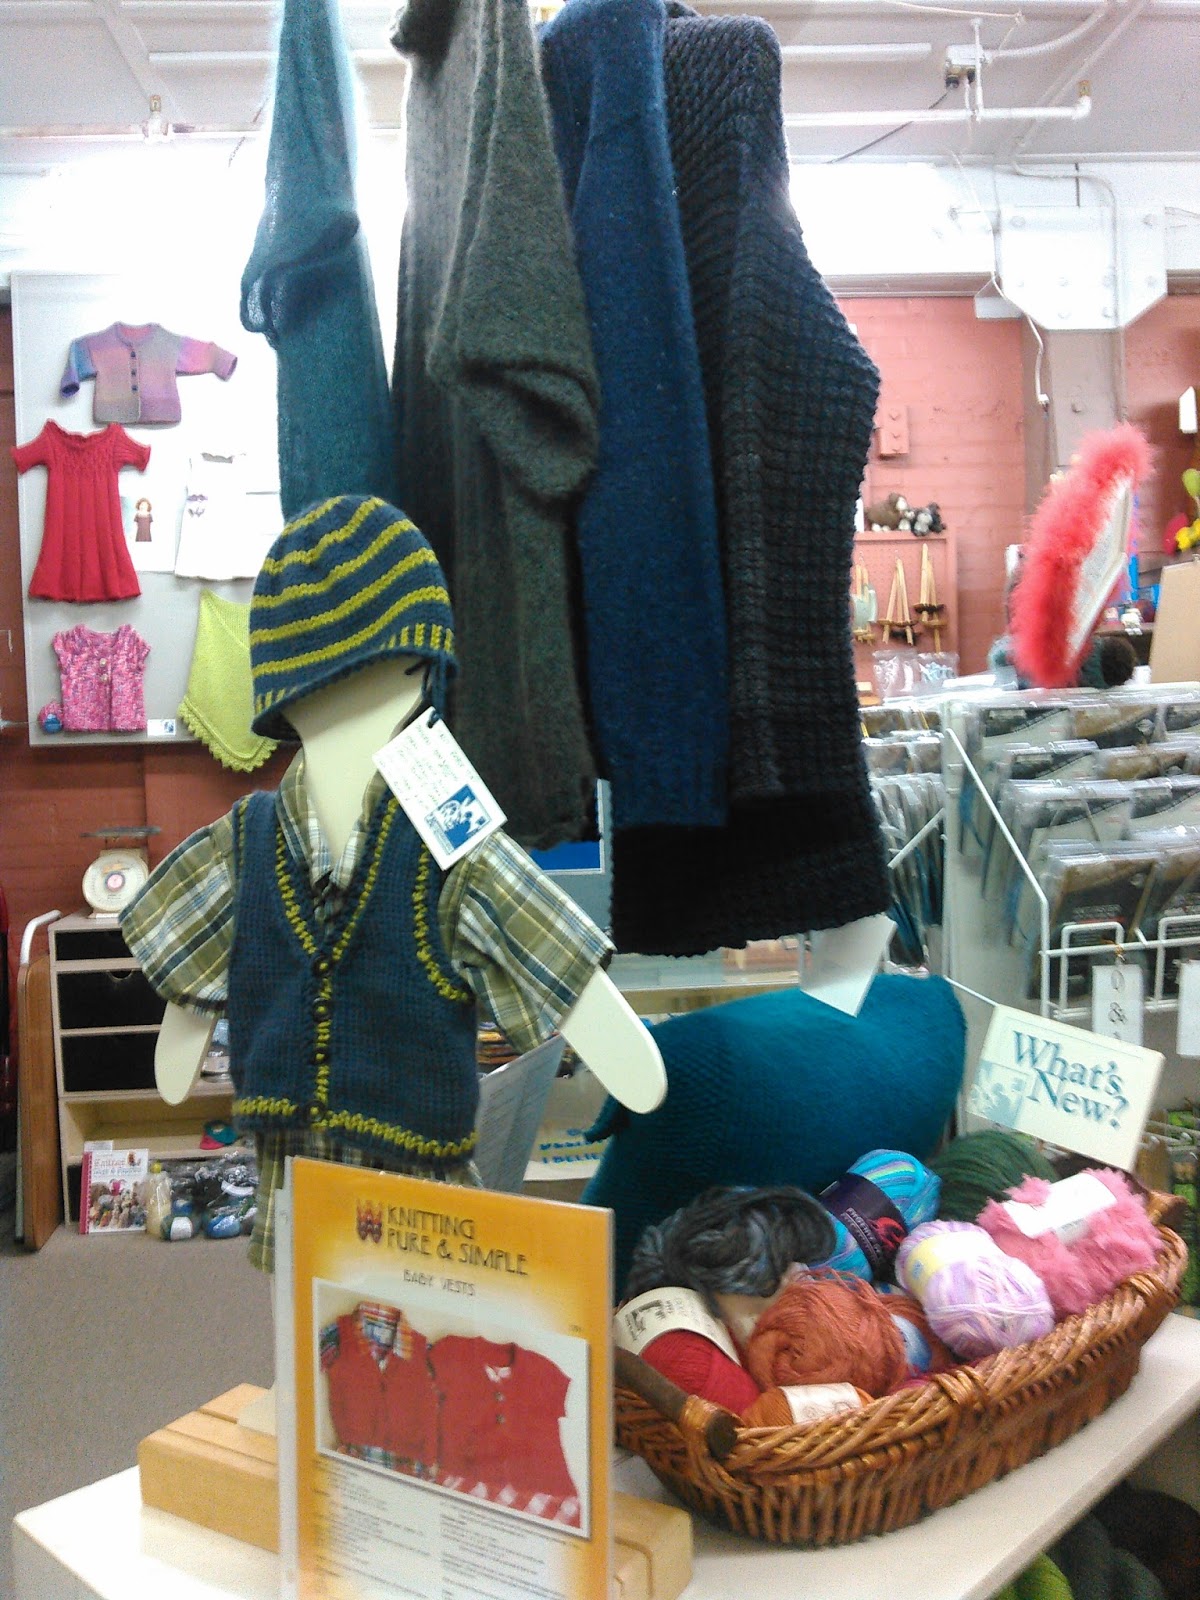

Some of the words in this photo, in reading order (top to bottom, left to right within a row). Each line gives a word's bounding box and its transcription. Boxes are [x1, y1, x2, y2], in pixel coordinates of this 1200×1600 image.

[1013, 1030, 1124, 1096] What's
[1026, 1067, 1130, 1129] New?
[387, 1204, 475, 1240] KNITTING
[387, 1227, 431, 1256] PURE
[436, 1238, 452, 1260] &
[458, 1242, 529, 1276] SIMPLE
[403, 1268, 434, 1288] BABY
[441, 1277, 476, 1296] VESTS
